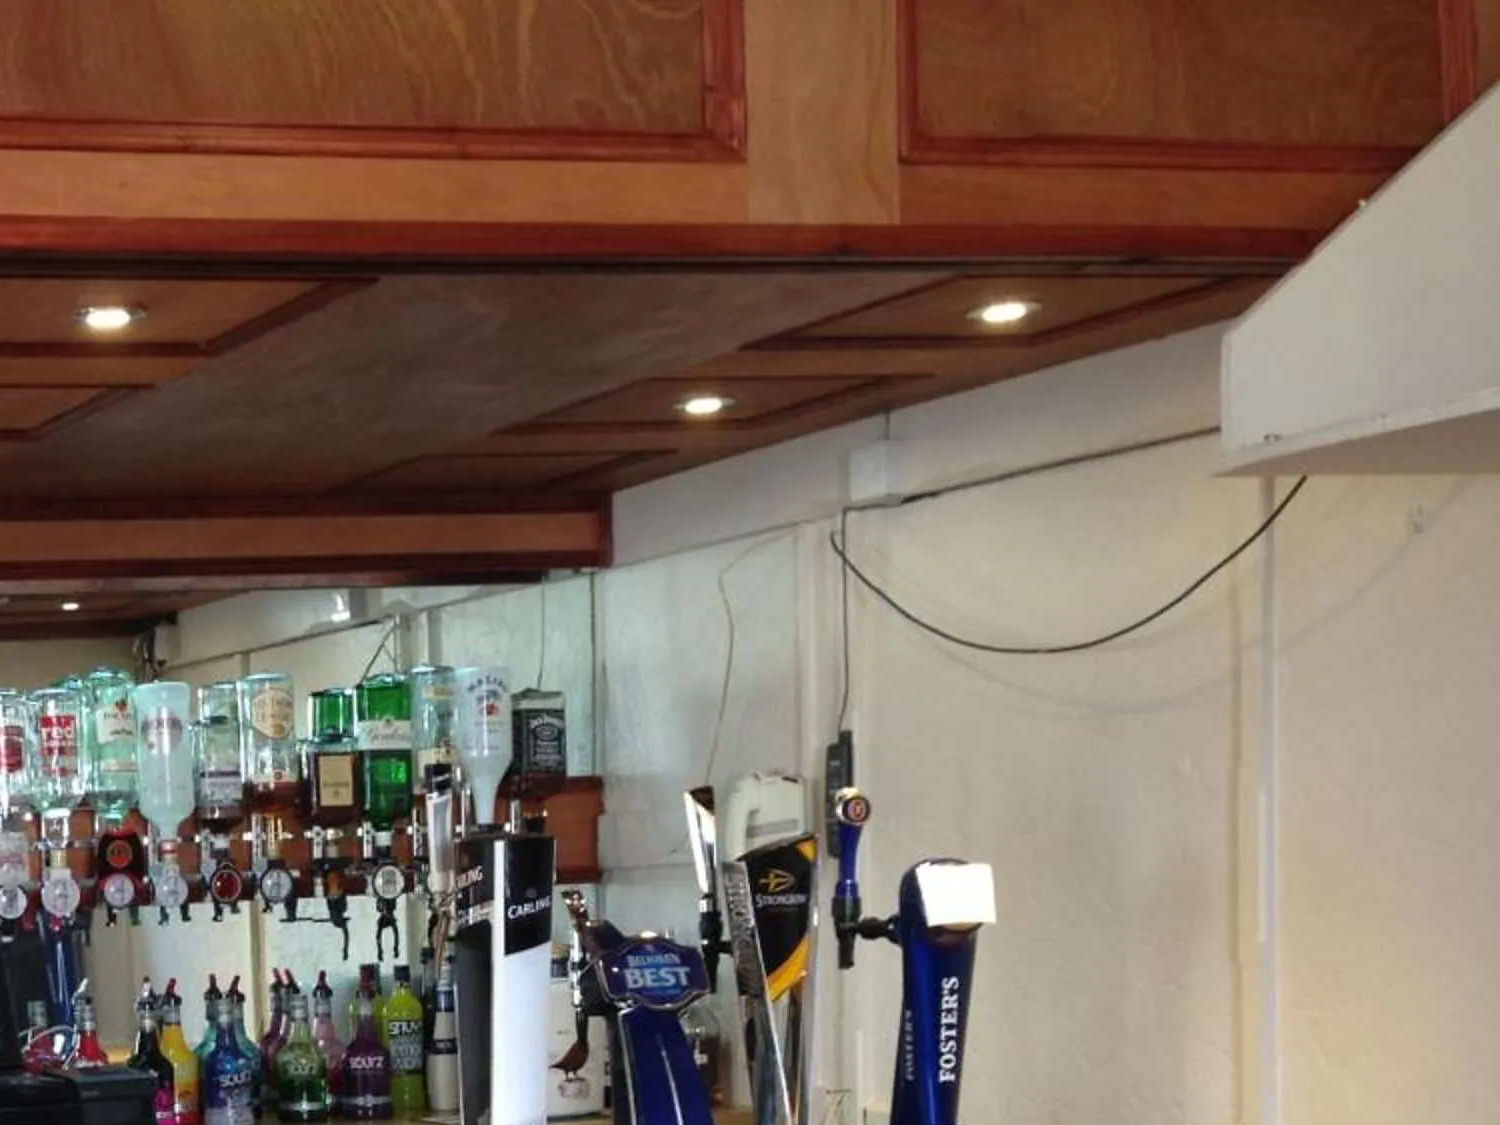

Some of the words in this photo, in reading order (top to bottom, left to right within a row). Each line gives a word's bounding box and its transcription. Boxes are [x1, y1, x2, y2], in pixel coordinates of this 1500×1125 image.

[507, 894, 552, 919] CARLING
[624, 966, 691, 989] BEST
[938, 975, 960, 1084] FOSTER'S
